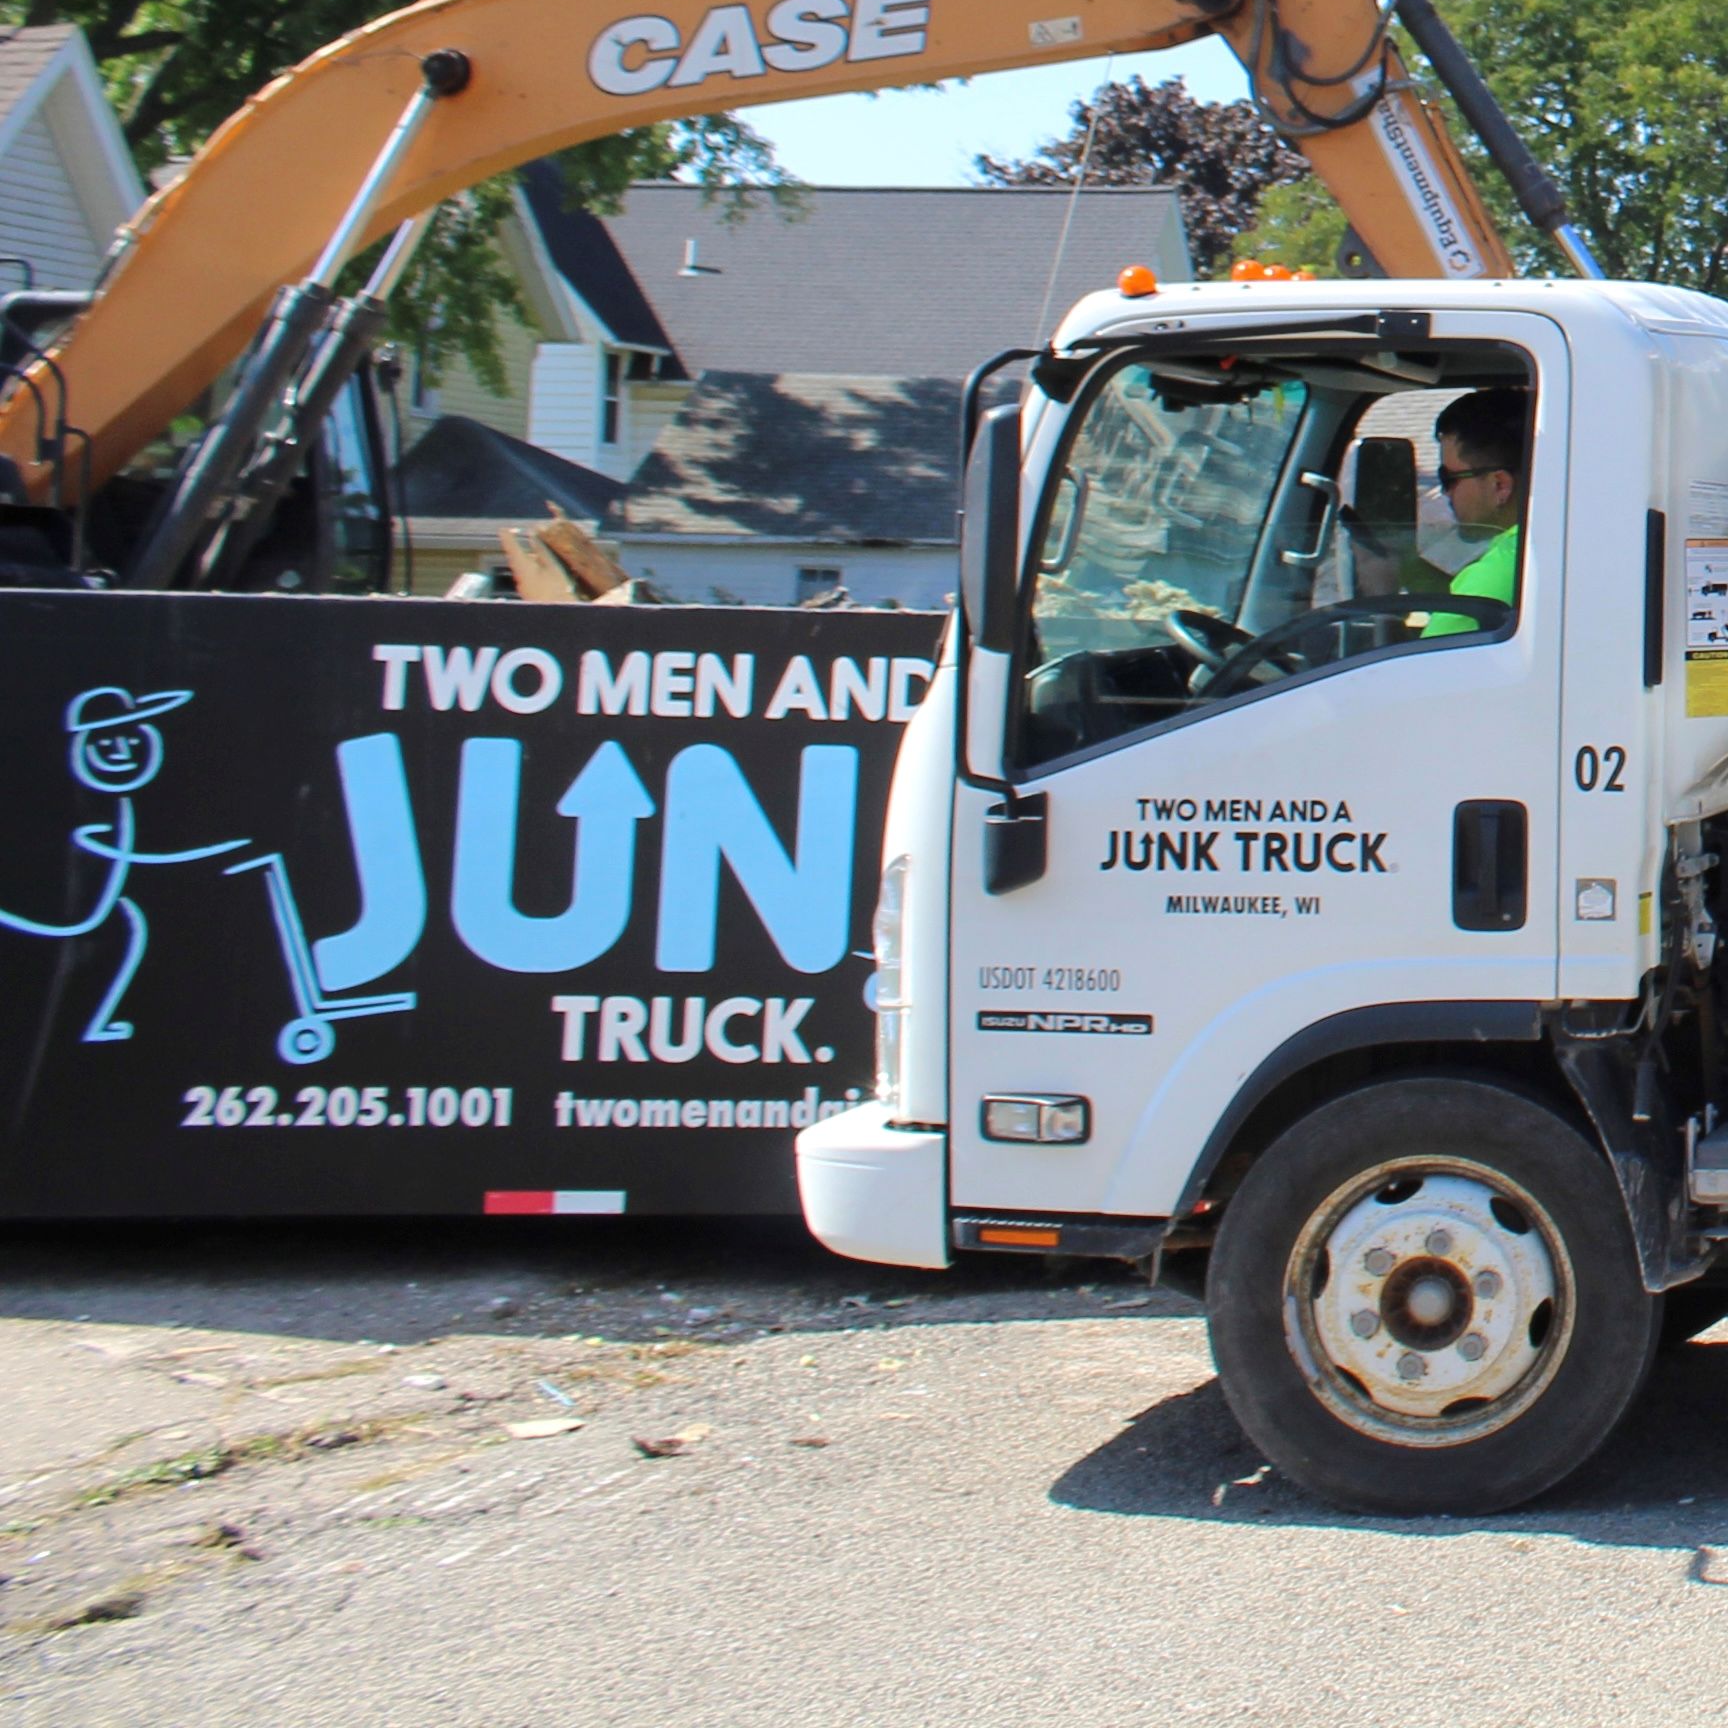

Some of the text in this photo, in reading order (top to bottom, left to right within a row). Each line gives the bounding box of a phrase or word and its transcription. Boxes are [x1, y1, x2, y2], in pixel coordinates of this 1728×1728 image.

[1366, 83, 1458, 249] EquipmentSha
[373, 644, 934, 722] TWO MEN AND
[1575, 746, 1627, 793] 02
[1138, 799, 1353, 823] TWO MEN AND A
[313, 732, 860, 992] JUN
[1101, 831, 1220, 872] JUNK
[1166, 895, 1321, 919] MILWAUKEE, WI
[979, 967, 1120, 992] USDOT 4218600
[182, 1087, 512, 1128] 262.205.1001
